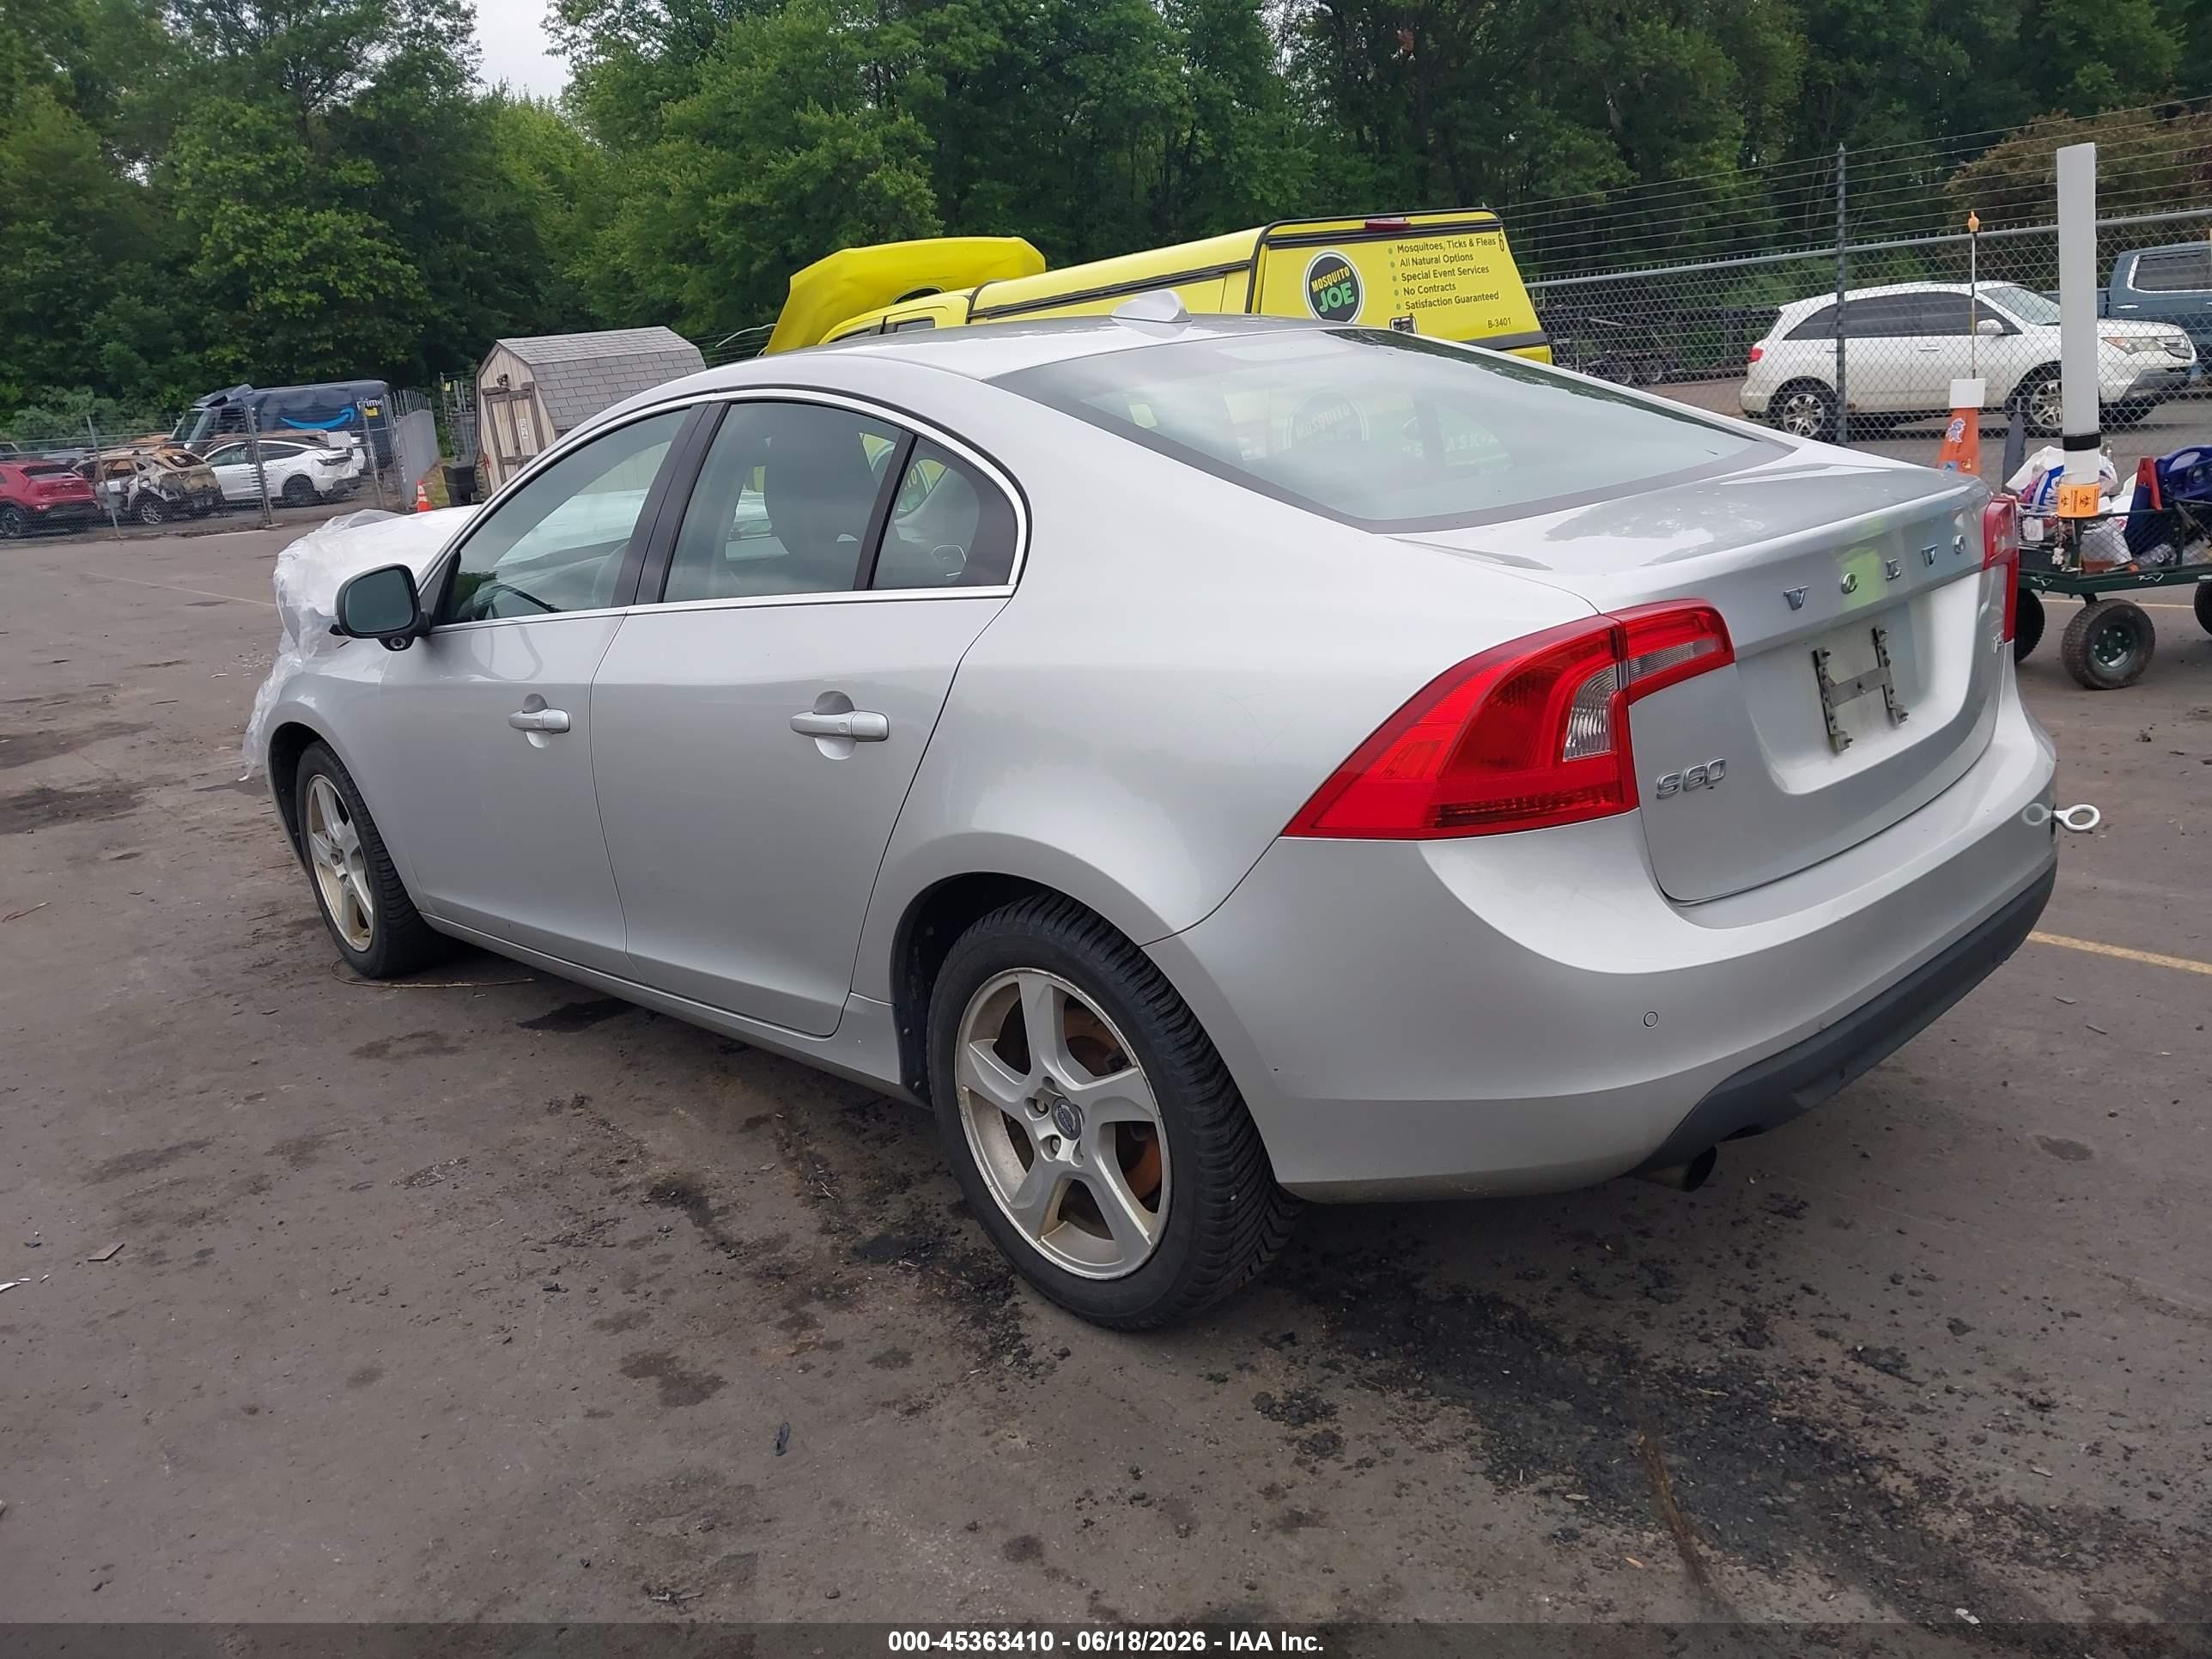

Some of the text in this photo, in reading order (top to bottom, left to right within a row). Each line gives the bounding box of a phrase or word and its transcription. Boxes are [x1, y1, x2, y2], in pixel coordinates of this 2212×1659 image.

[1396, 237, 1497, 254] Mosquitoes, Ticks & Fleas
[1400, 252, 1474, 268] All Natural Options
[1311, 266, 1351, 293] MOSQUITO
[1401, 264, 1490, 283] Special Event Services
[1319, 281, 1355, 313] JOE
[1403, 283, 1457, 296] No Contracts
[1405, 290, 1499, 310] Satisfaction Guaranteed
[1487, 317, 1511, 329] B-3401
[1784, 534, 1966, 611] VOLVO
[1656, 757, 1727, 799] S60
